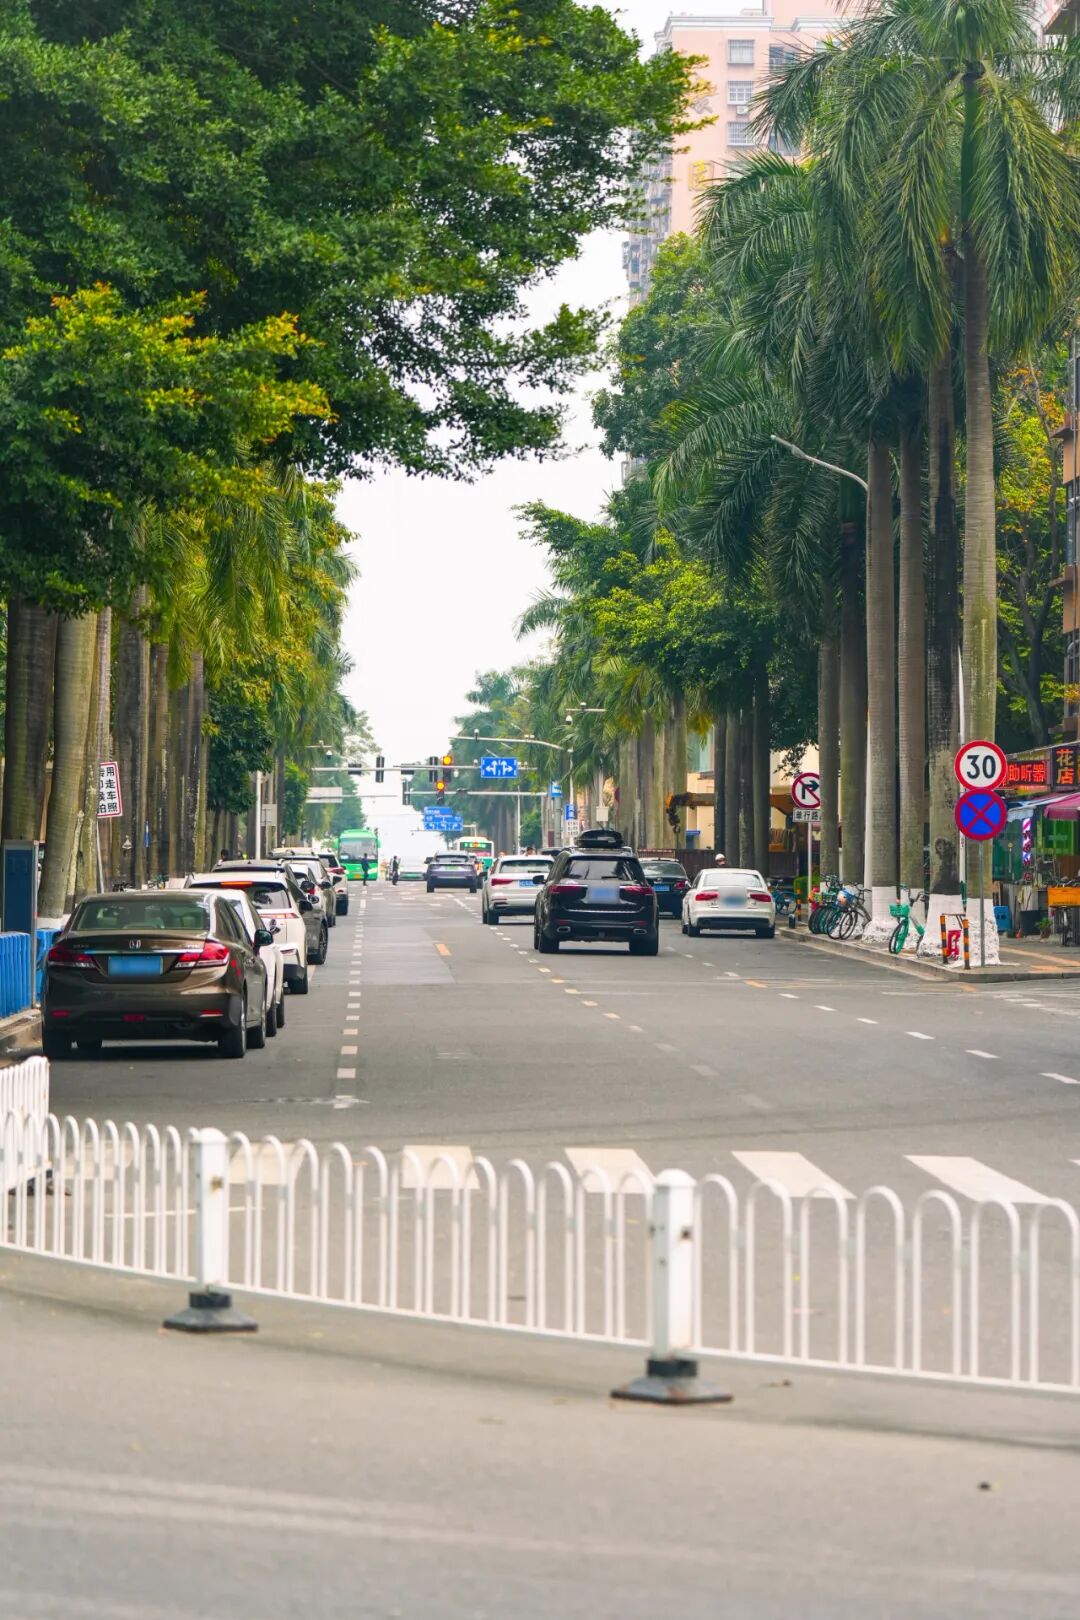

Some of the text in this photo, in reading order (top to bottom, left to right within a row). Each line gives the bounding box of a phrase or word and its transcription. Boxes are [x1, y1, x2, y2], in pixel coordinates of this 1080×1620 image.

[966, 754, 996, 780] 30
[1008, 763, 1045, 783] 助听器
[1056, 748, 1075, 785] 花店
